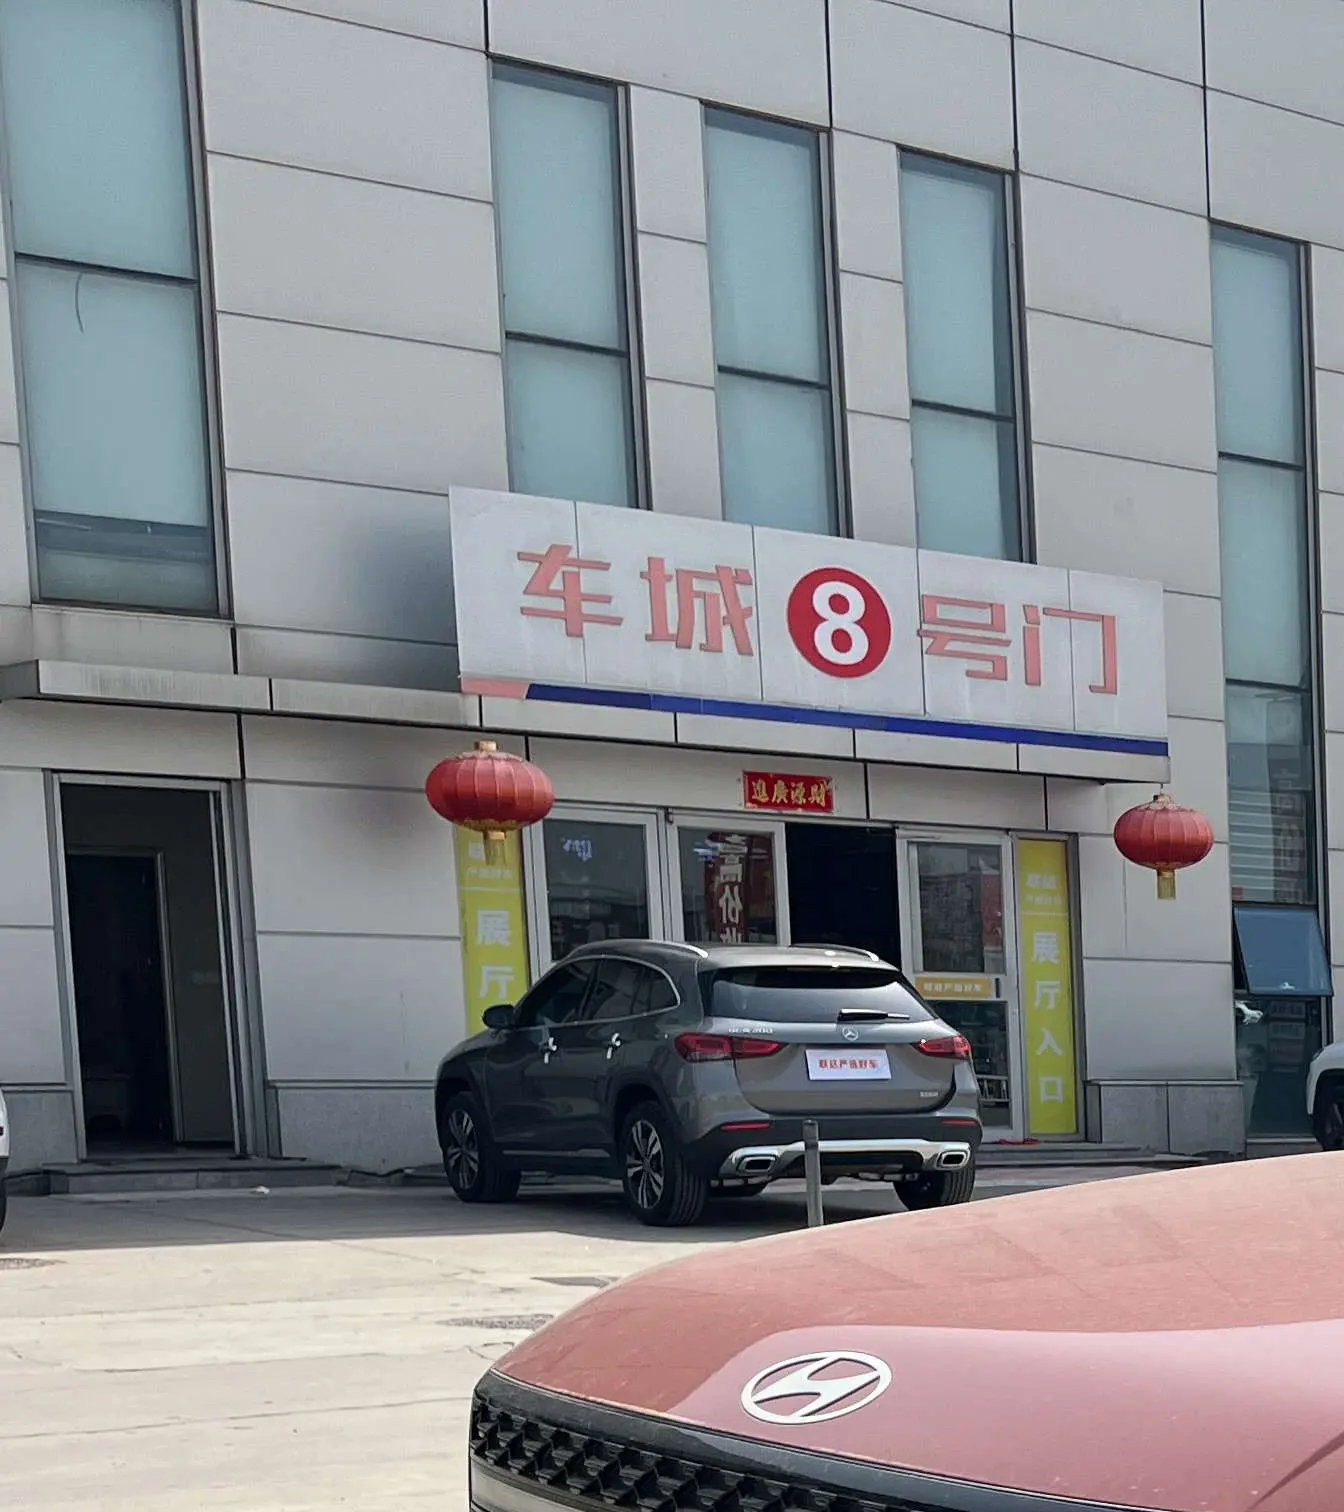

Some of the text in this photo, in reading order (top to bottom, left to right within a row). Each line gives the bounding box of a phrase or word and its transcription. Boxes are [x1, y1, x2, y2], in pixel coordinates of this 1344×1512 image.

[516, 543, 1120, 695] 车城8号门
[1031, 931, 1066, 1104] 展厅入口
